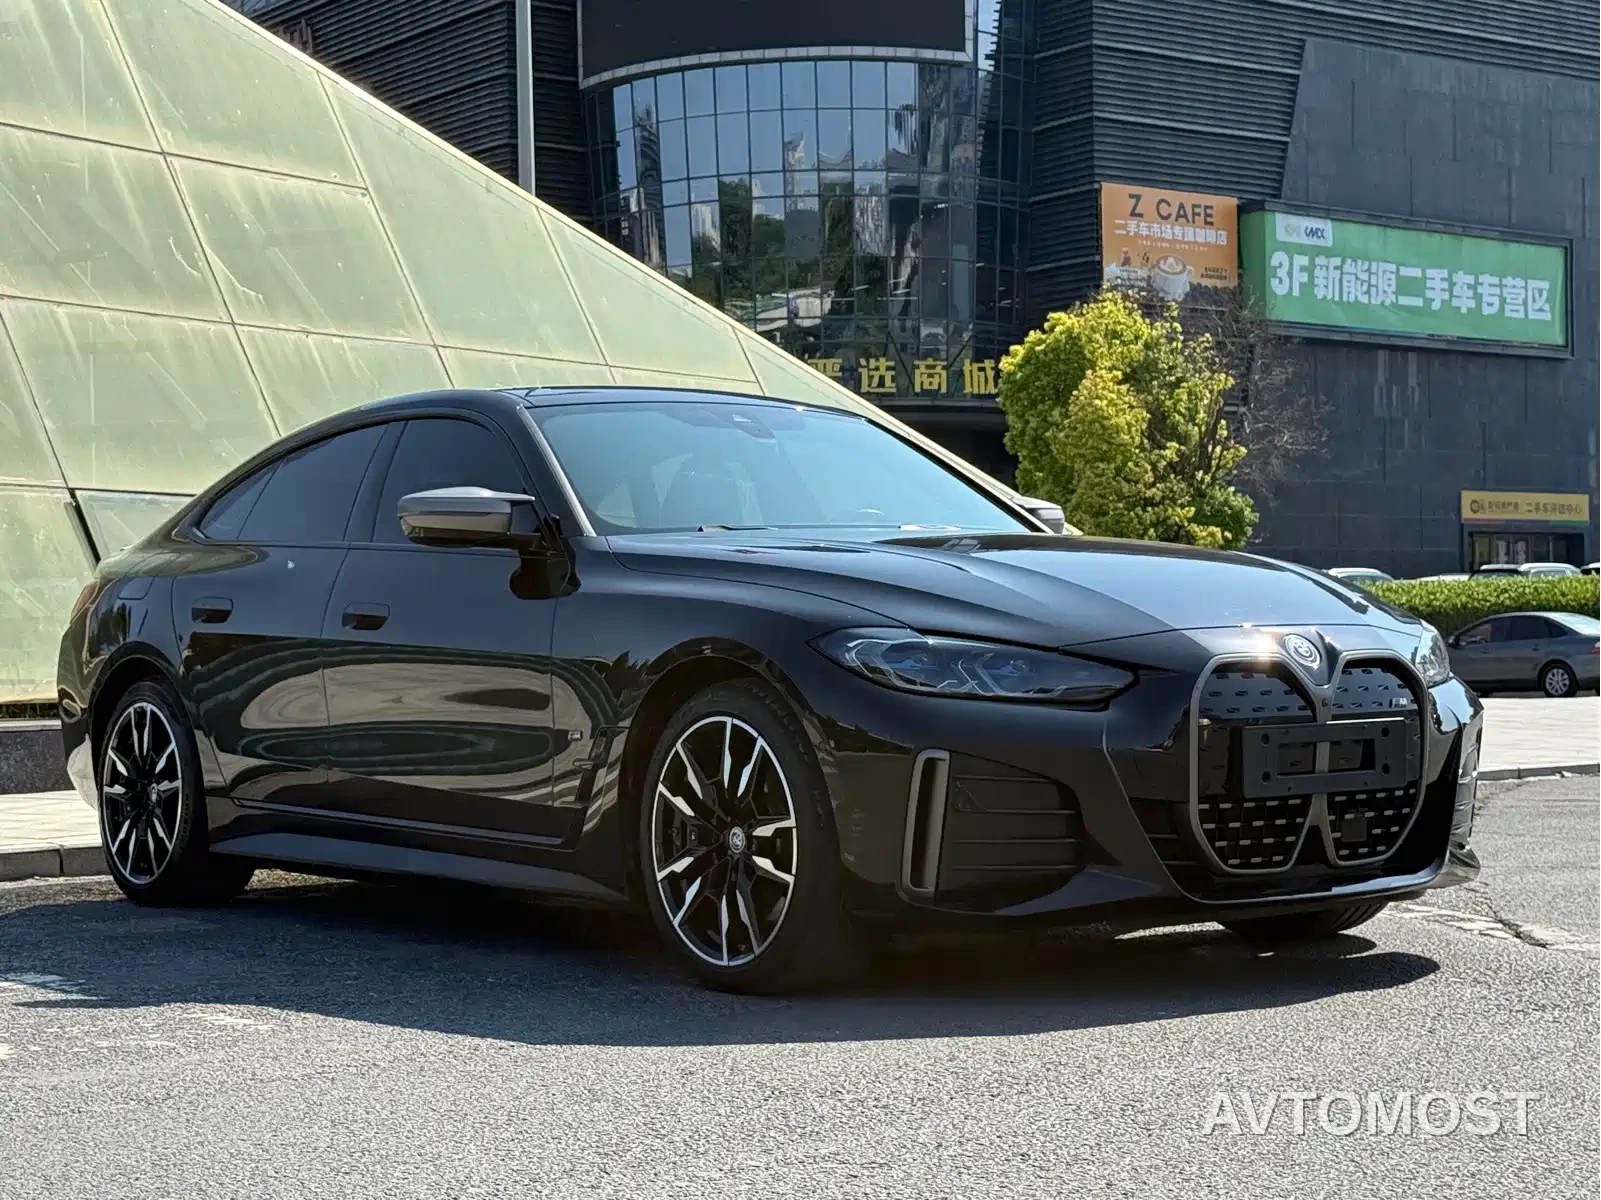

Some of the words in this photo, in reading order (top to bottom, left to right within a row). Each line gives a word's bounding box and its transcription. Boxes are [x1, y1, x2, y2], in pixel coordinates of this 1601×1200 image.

[1128, 193, 1144, 218] Z
[1155, 197, 1215, 227] CAFE
[1270, 250, 1309, 297] 3F
[1313, 254, 1552, 321] 新能源二手车专营区
